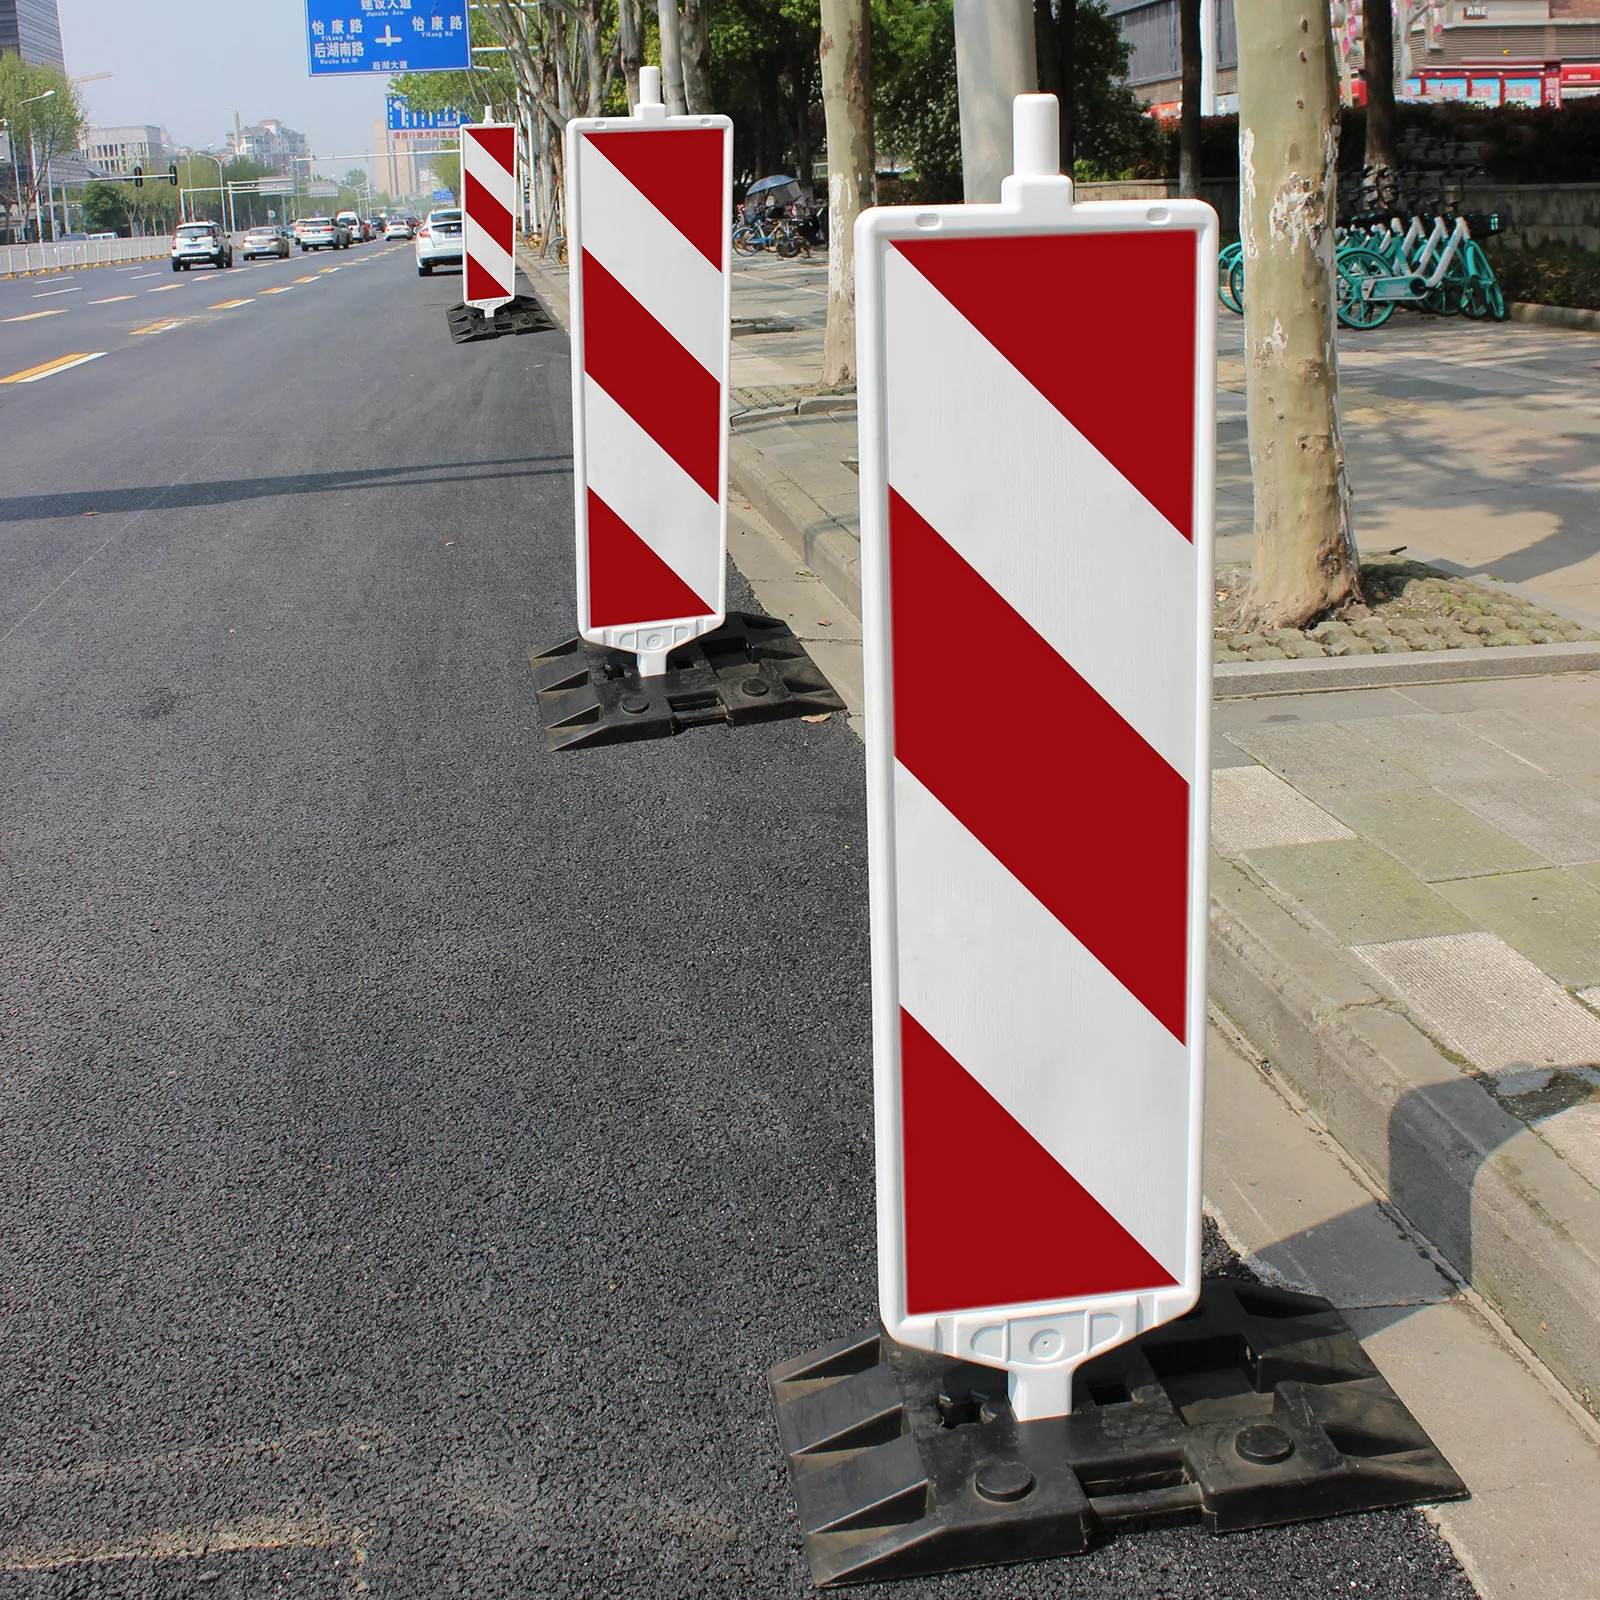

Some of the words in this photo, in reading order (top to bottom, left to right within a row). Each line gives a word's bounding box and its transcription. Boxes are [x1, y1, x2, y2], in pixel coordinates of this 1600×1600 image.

[312, 18, 363, 35] 怡康路
[412, 15, 463, 31] 怡康路
[314, 41, 364, 58] 后湖南路
[372, 60, 408, 70] 后湖大道
